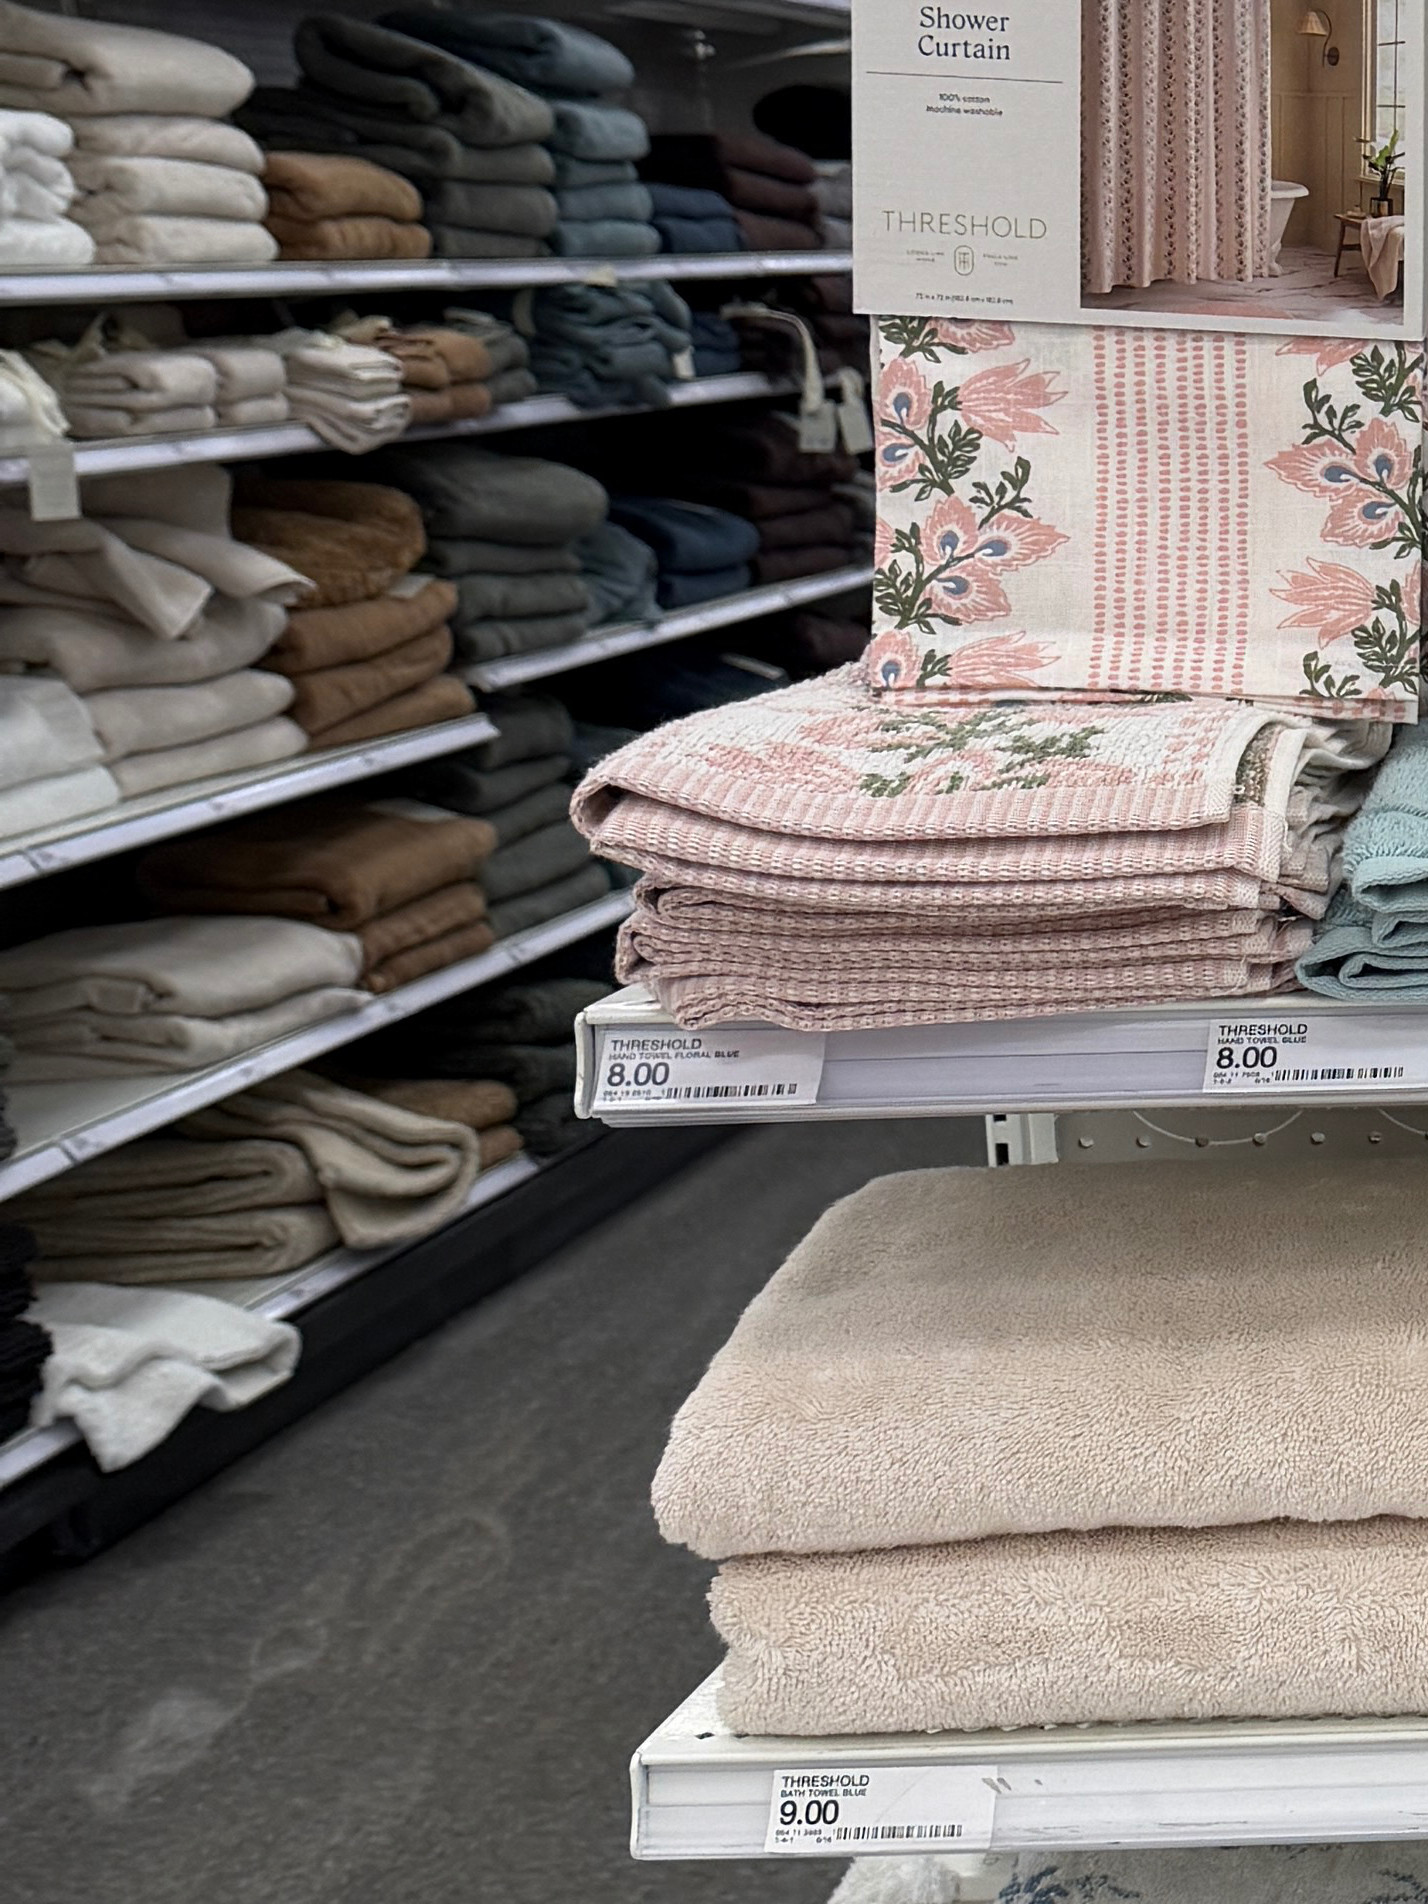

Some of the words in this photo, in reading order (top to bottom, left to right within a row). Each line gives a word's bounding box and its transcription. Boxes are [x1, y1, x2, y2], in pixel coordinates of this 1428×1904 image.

[920, 6, 1009, 31] Shower
[918, 35, 1010, 60] Curtain
[882, 210, 1047, 239] THRESHOLD
[1218, 1023, 1308, 1036] THRESHOLD
[611, 1038, 702, 1051] THRESHOLD
[714, 1050, 740, 1058] BLUE
[1216, 1046, 1277, 1069] 8.00
[607, 1062, 670, 1087] 8.00
[782, 1774, 869, 1788] THRESHOLD
[843, 1788, 867, 1796] BLUE
[779, 1799, 839, 1825] 9.00
